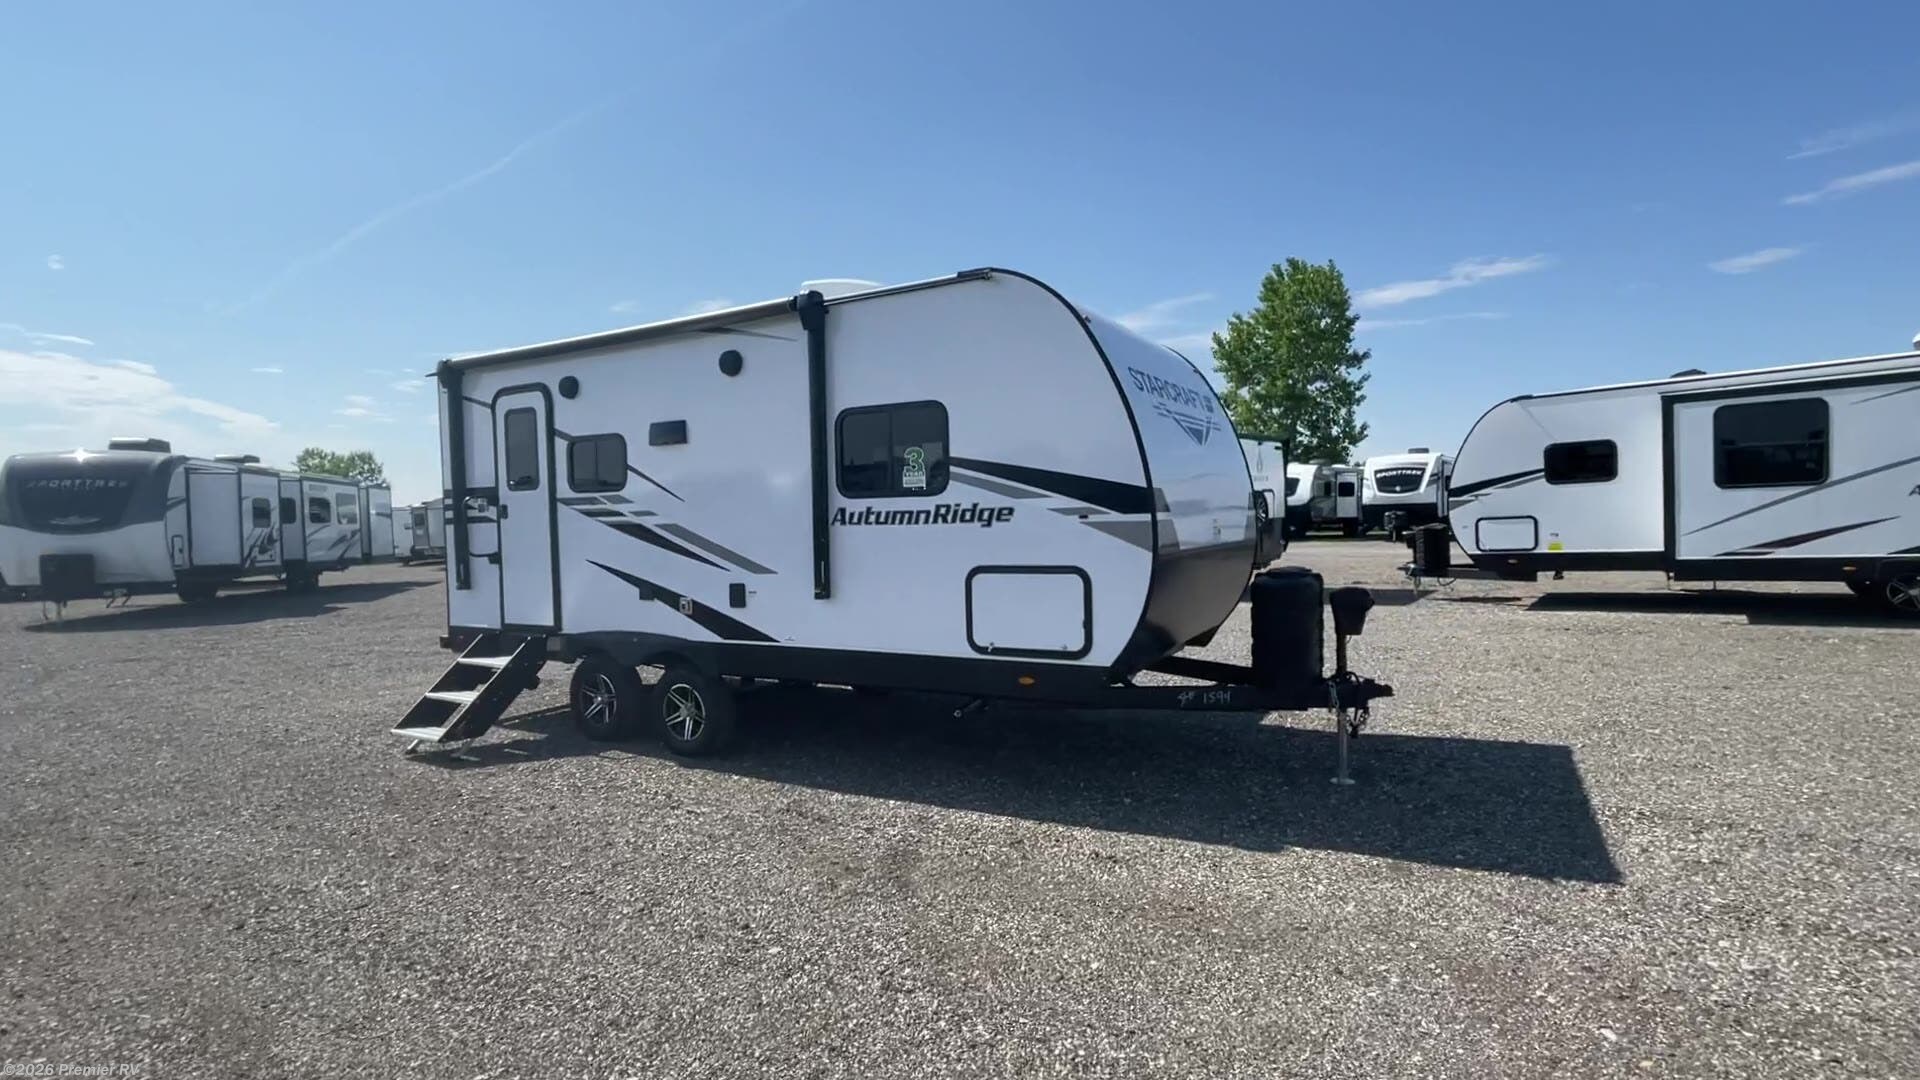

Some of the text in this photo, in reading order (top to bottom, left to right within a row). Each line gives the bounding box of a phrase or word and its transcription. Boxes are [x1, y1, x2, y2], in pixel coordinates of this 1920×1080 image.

[1128, 366, 1205, 411] STARCRAFT
[904, 446, 925, 472] 3
[831, 502, 1015, 528] AutumnRidge
